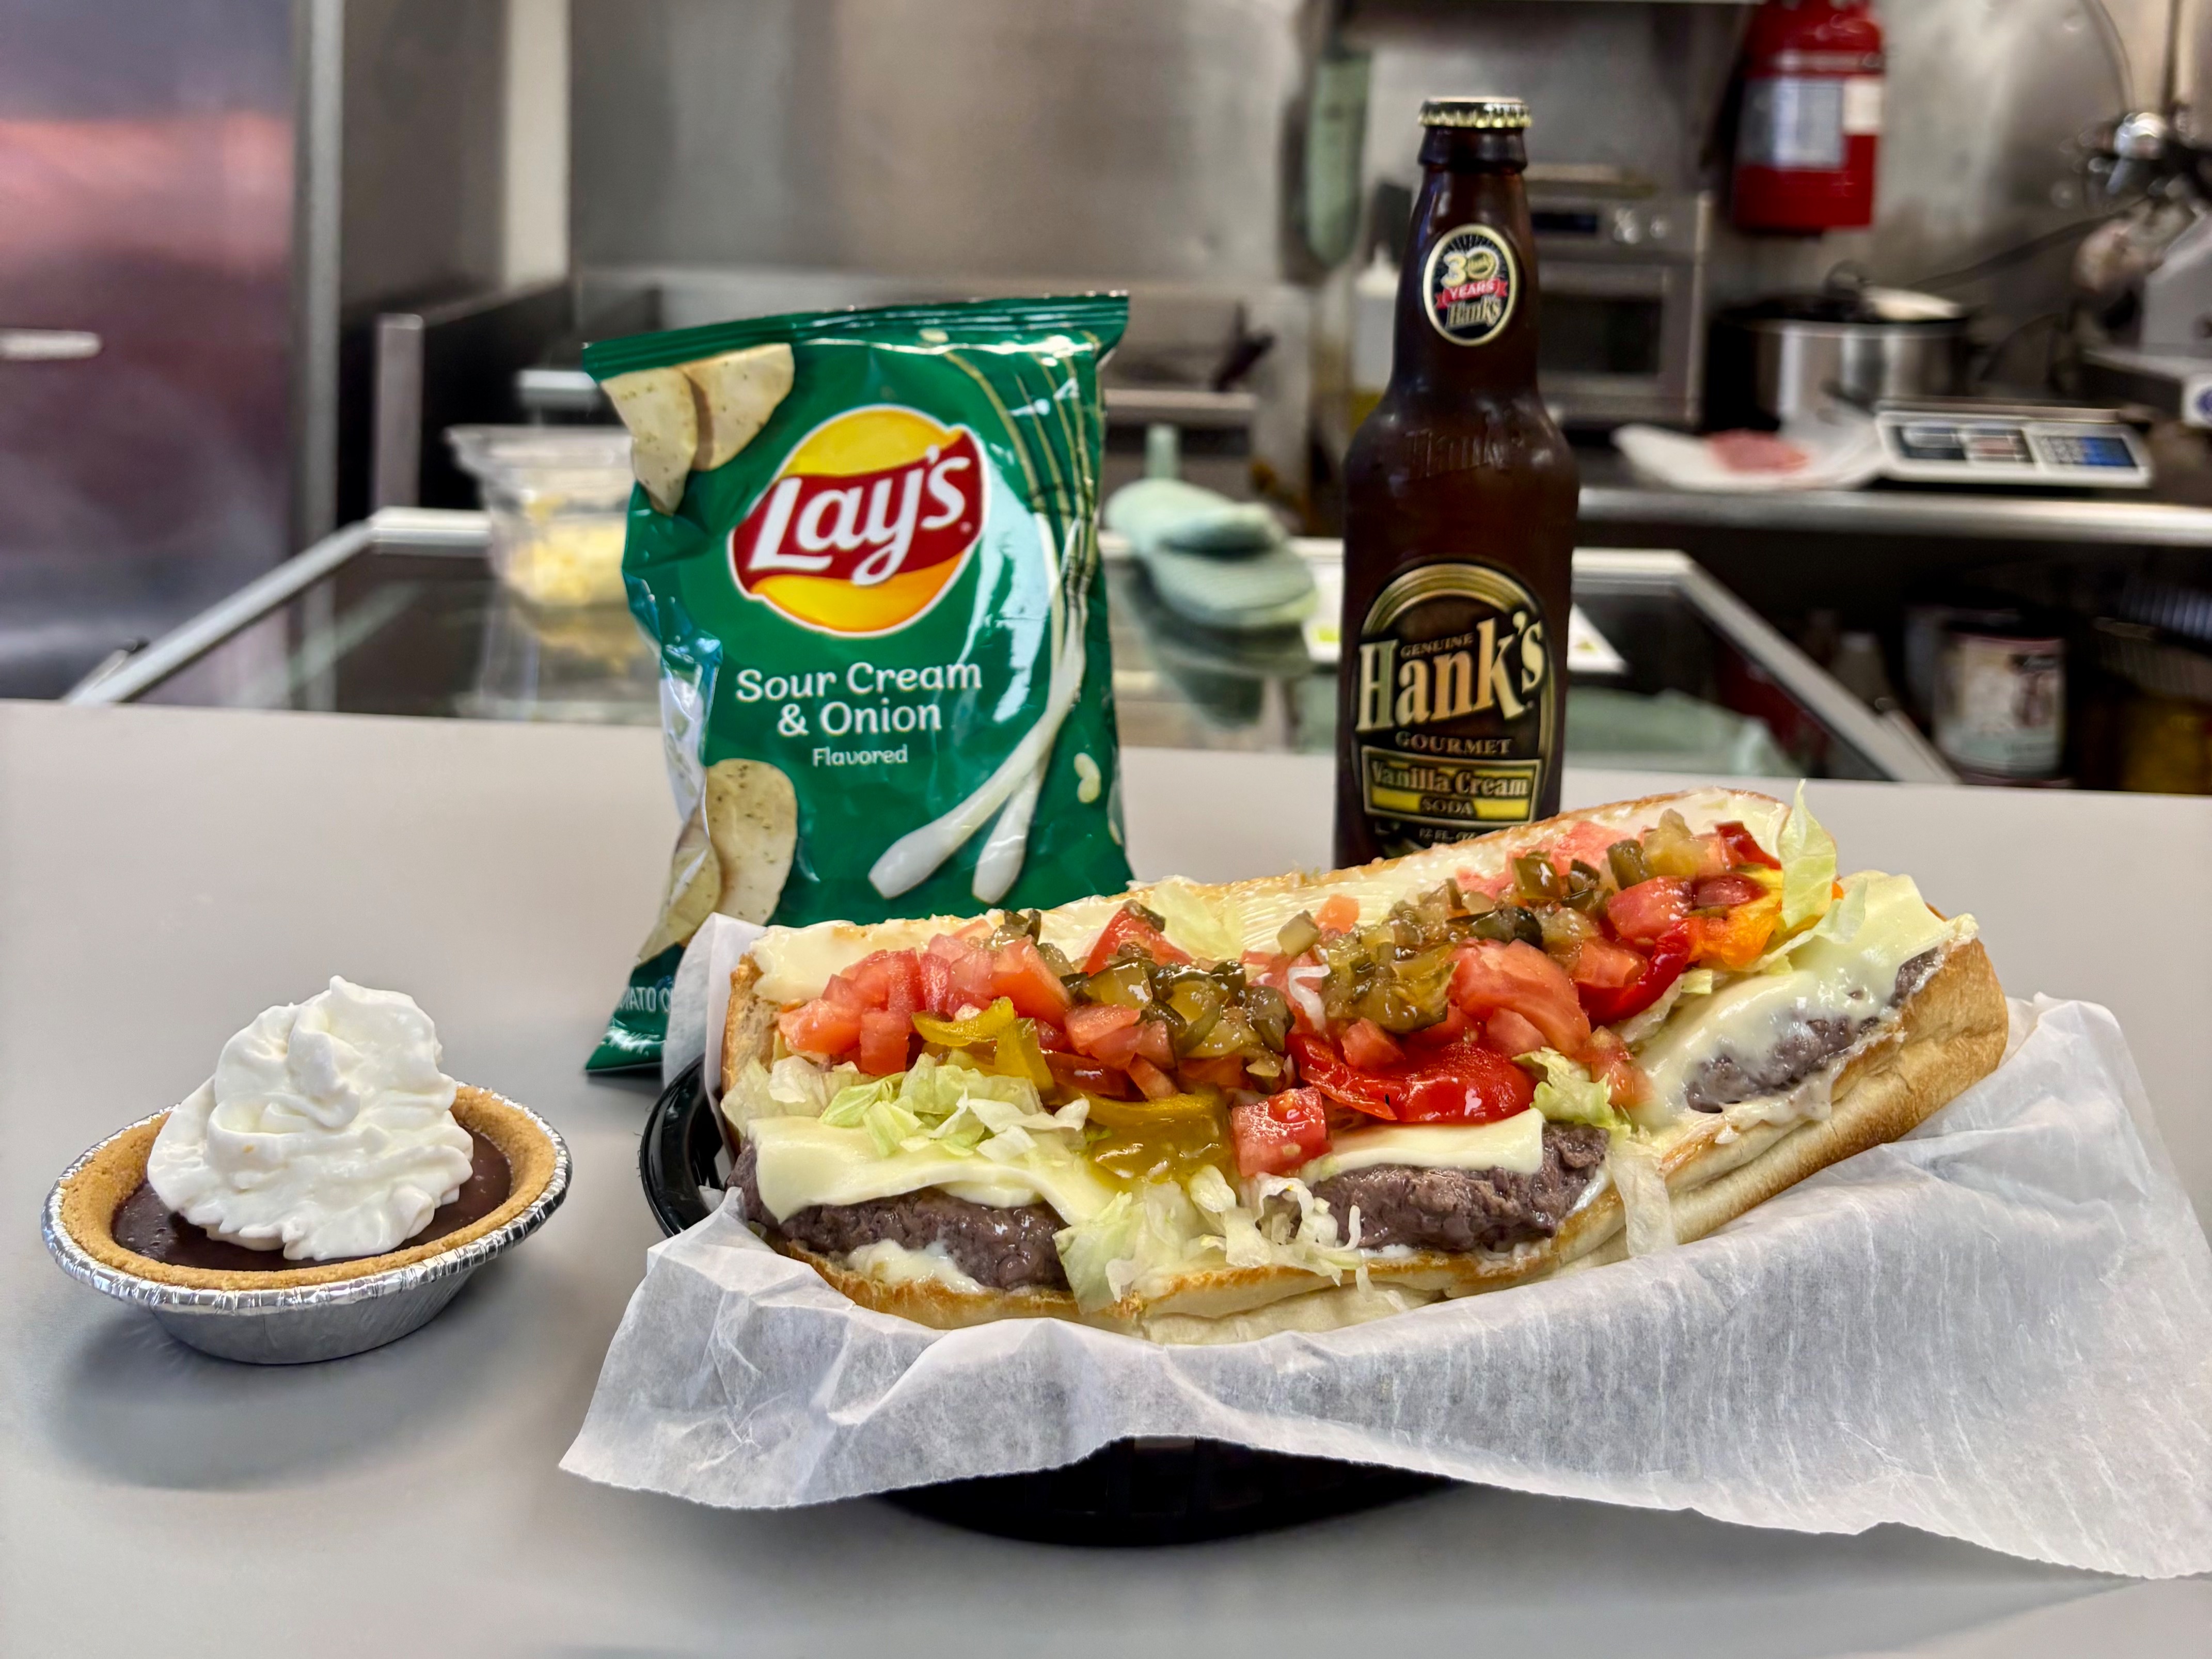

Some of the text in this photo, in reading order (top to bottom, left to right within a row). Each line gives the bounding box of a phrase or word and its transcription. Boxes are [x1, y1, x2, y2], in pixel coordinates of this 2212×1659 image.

[1441, 249, 1498, 287] 30
[1449, 280, 1495, 301] YEARS
[748, 445, 971, 586] Lay's
[1400, 633, 1474, 657] GENUINE
[735, 661, 982, 702] Sour Cream
[1355, 611, 1545, 731] Hank's
[777, 698, 942, 737] & Onion
[812, 745, 909, 767] Flavored
[1395, 730, 1513, 756] GOURMET
[1370, 759, 1528, 797] Vanilla Cream
[1420, 797, 1475, 817] SODA
